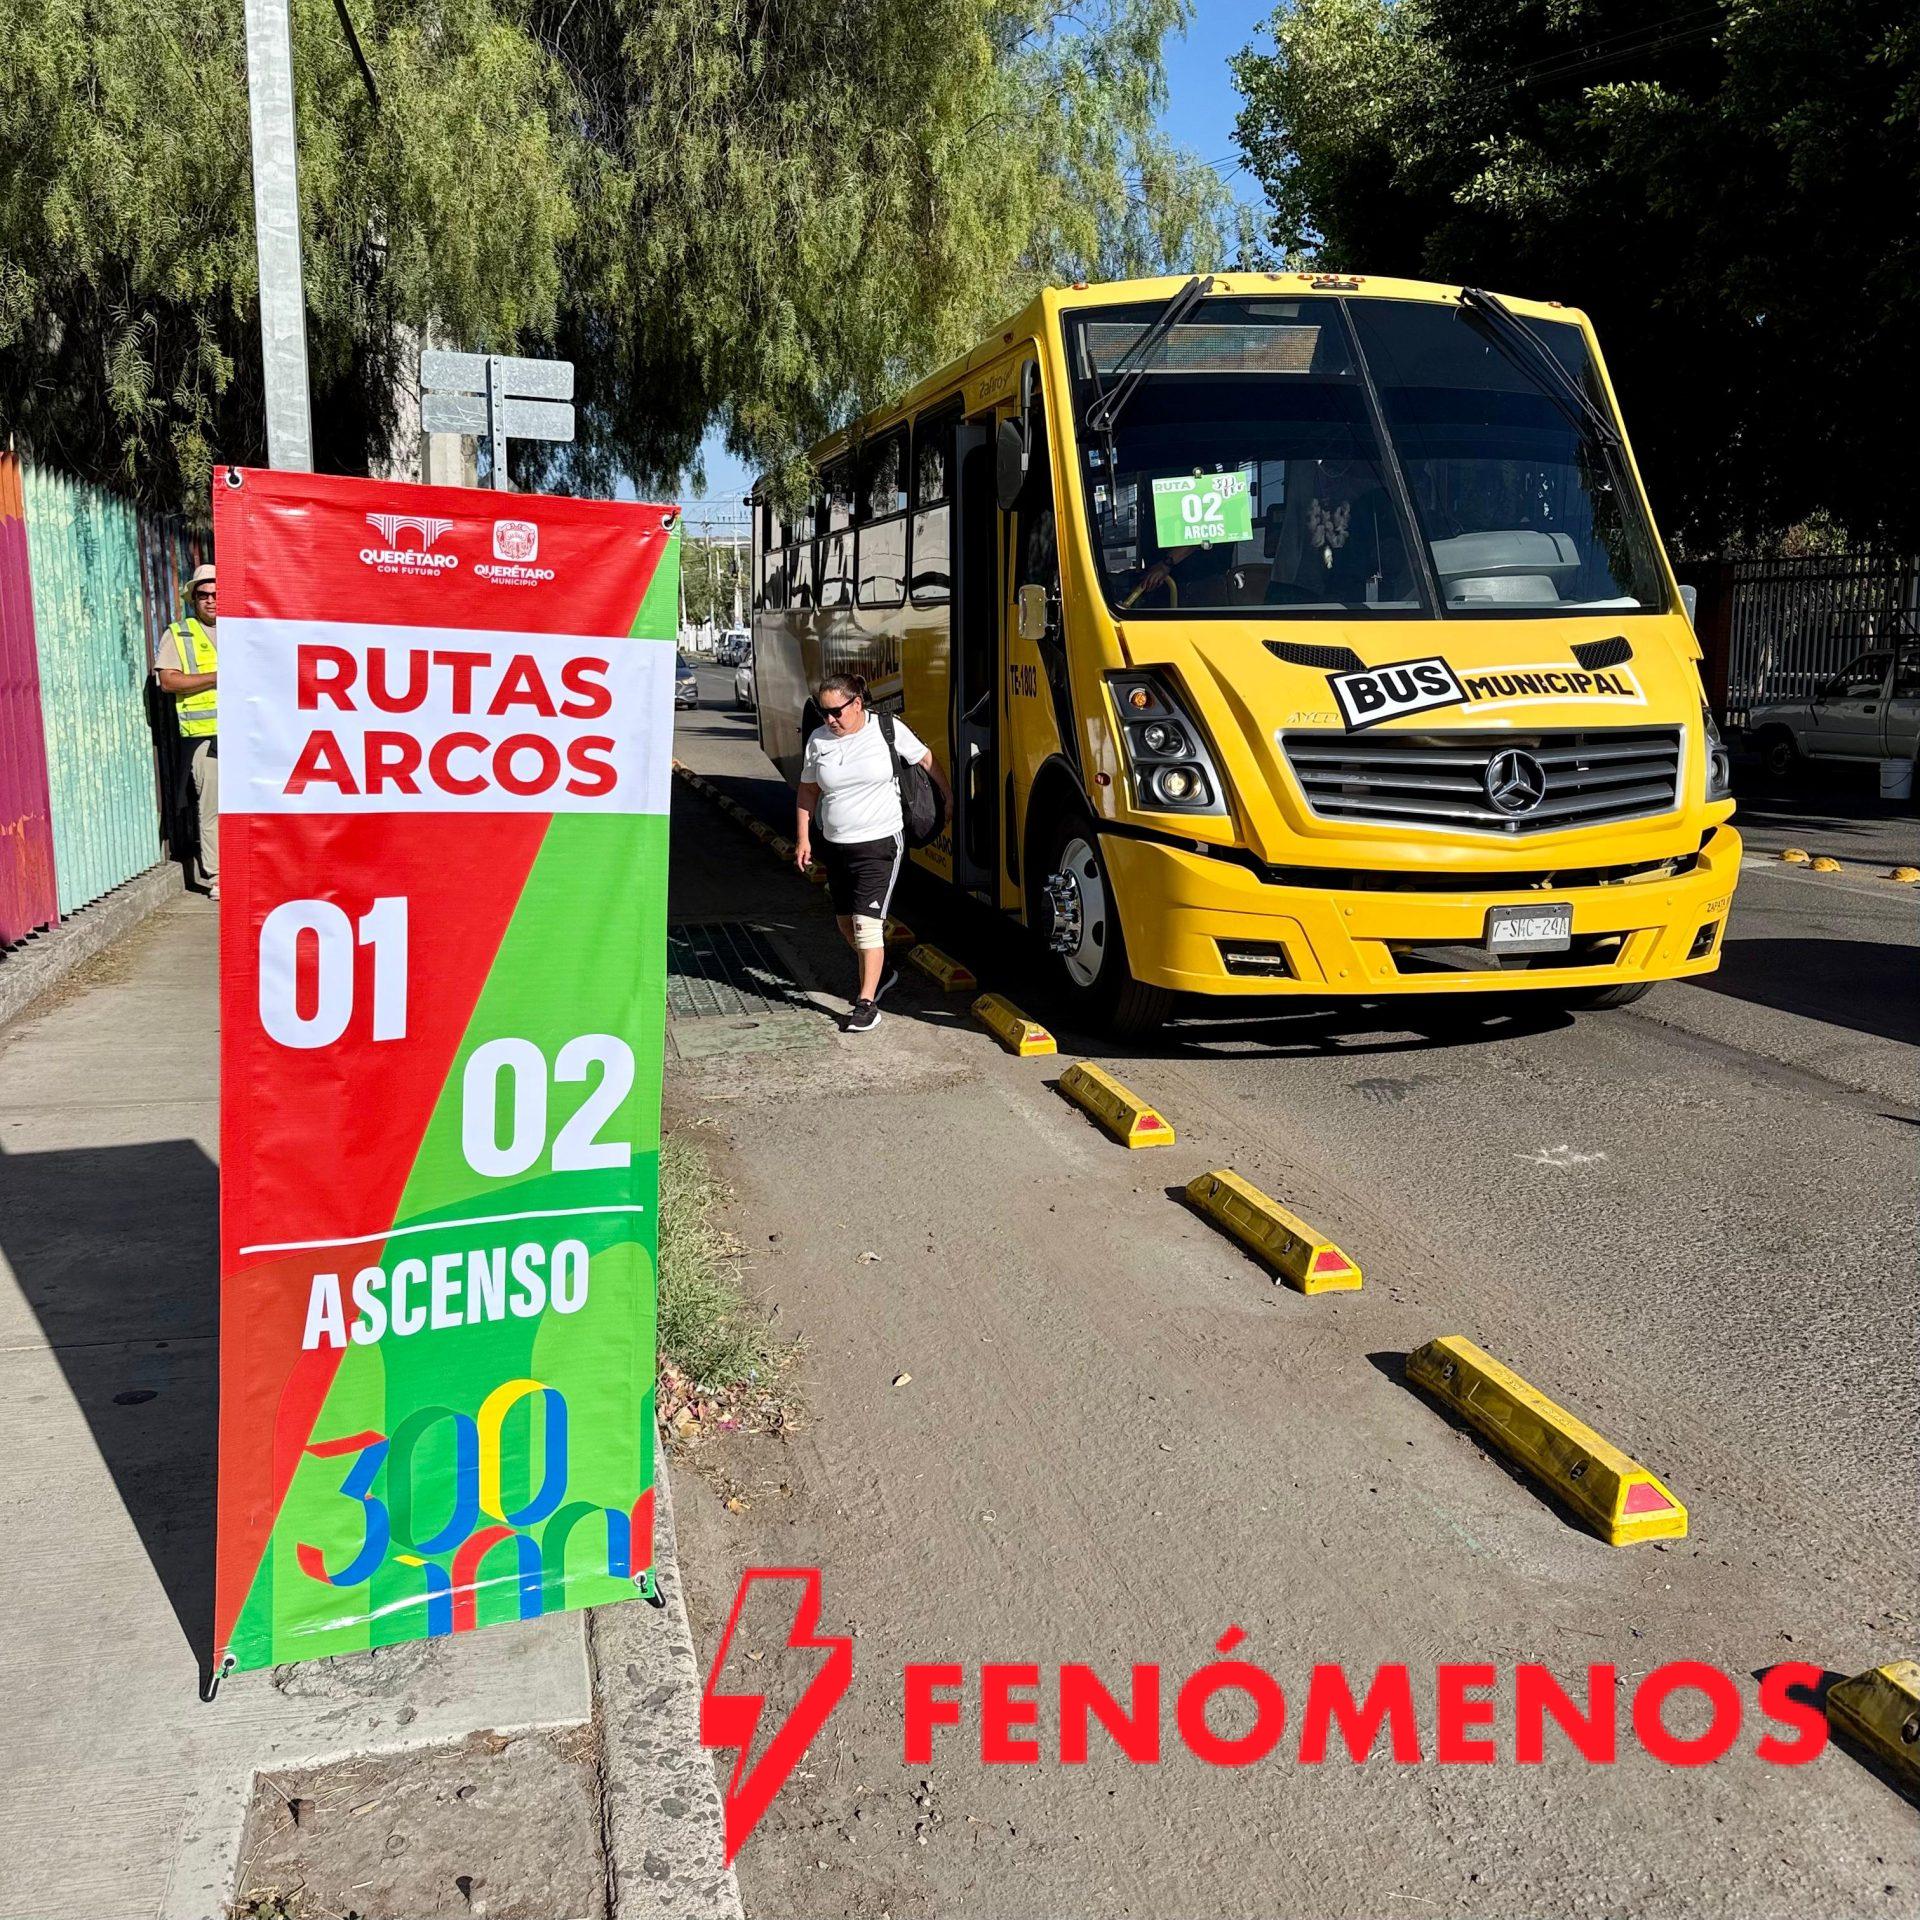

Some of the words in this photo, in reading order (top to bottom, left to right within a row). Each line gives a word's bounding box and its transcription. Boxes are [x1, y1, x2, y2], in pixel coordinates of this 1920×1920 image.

[1154, 481, 1191, 492] RUTA
[1181, 492, 1224, 523] 02
[1184, 524, 1225, 540] ARCOS
[359, 548, 459, 568] QUERÉTARO
[377, 564, 399, 574] CON
[401, 566, 441, 577] FUTURO
[473, 564, 555, 580] QUERÉTARO
[490, 577, 538, 587] MUNICIPIO
[297, 643, 613, 720] RUTAS
[1345, 665, 1451, 714] BUS
[1464, 672, 1635, 700] MUNICIPAL
[282, 729, 618, 797] ARCOS
[259, 896, 408, 1049] 01
[461, 1033, 636, 1178] 02
[302, 1239, 590, 1350] ASCENSO
